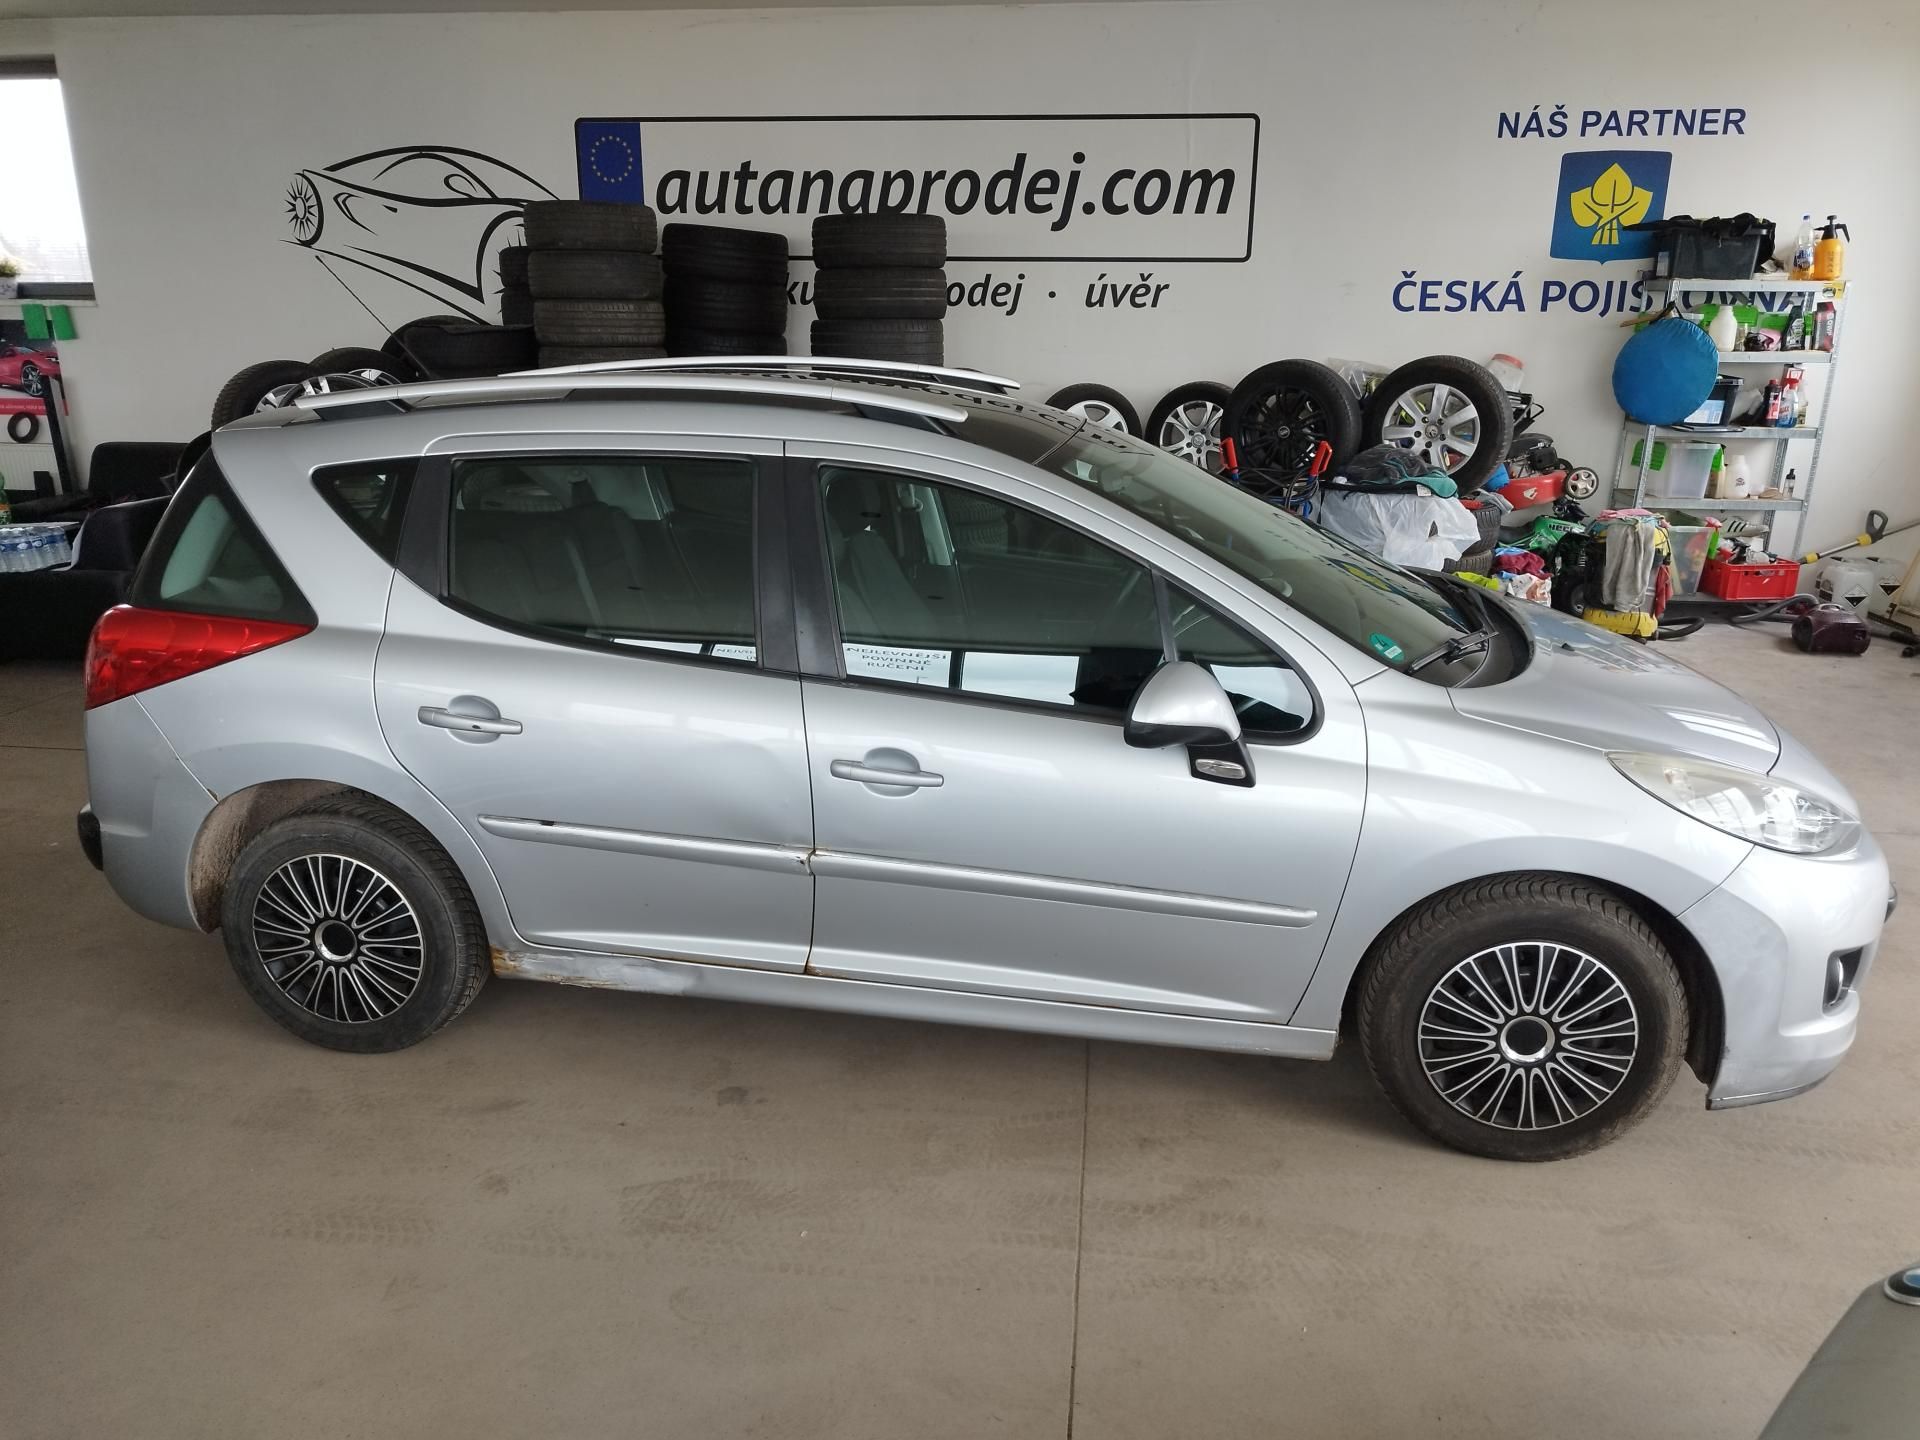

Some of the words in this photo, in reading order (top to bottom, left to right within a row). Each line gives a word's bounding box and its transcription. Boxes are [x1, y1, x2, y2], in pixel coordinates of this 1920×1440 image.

[1498, 104, 1568, 139] NÁŠ
[1580, 108, 1747, 138] PARTNER
[655, 151, 1236, 232] autanaprodej.com
[946, 272, 1025, 316] odej
[1085, 272, 1170, 309] úvěr
[1392, 270, 1526, 313] ČESKÁ
